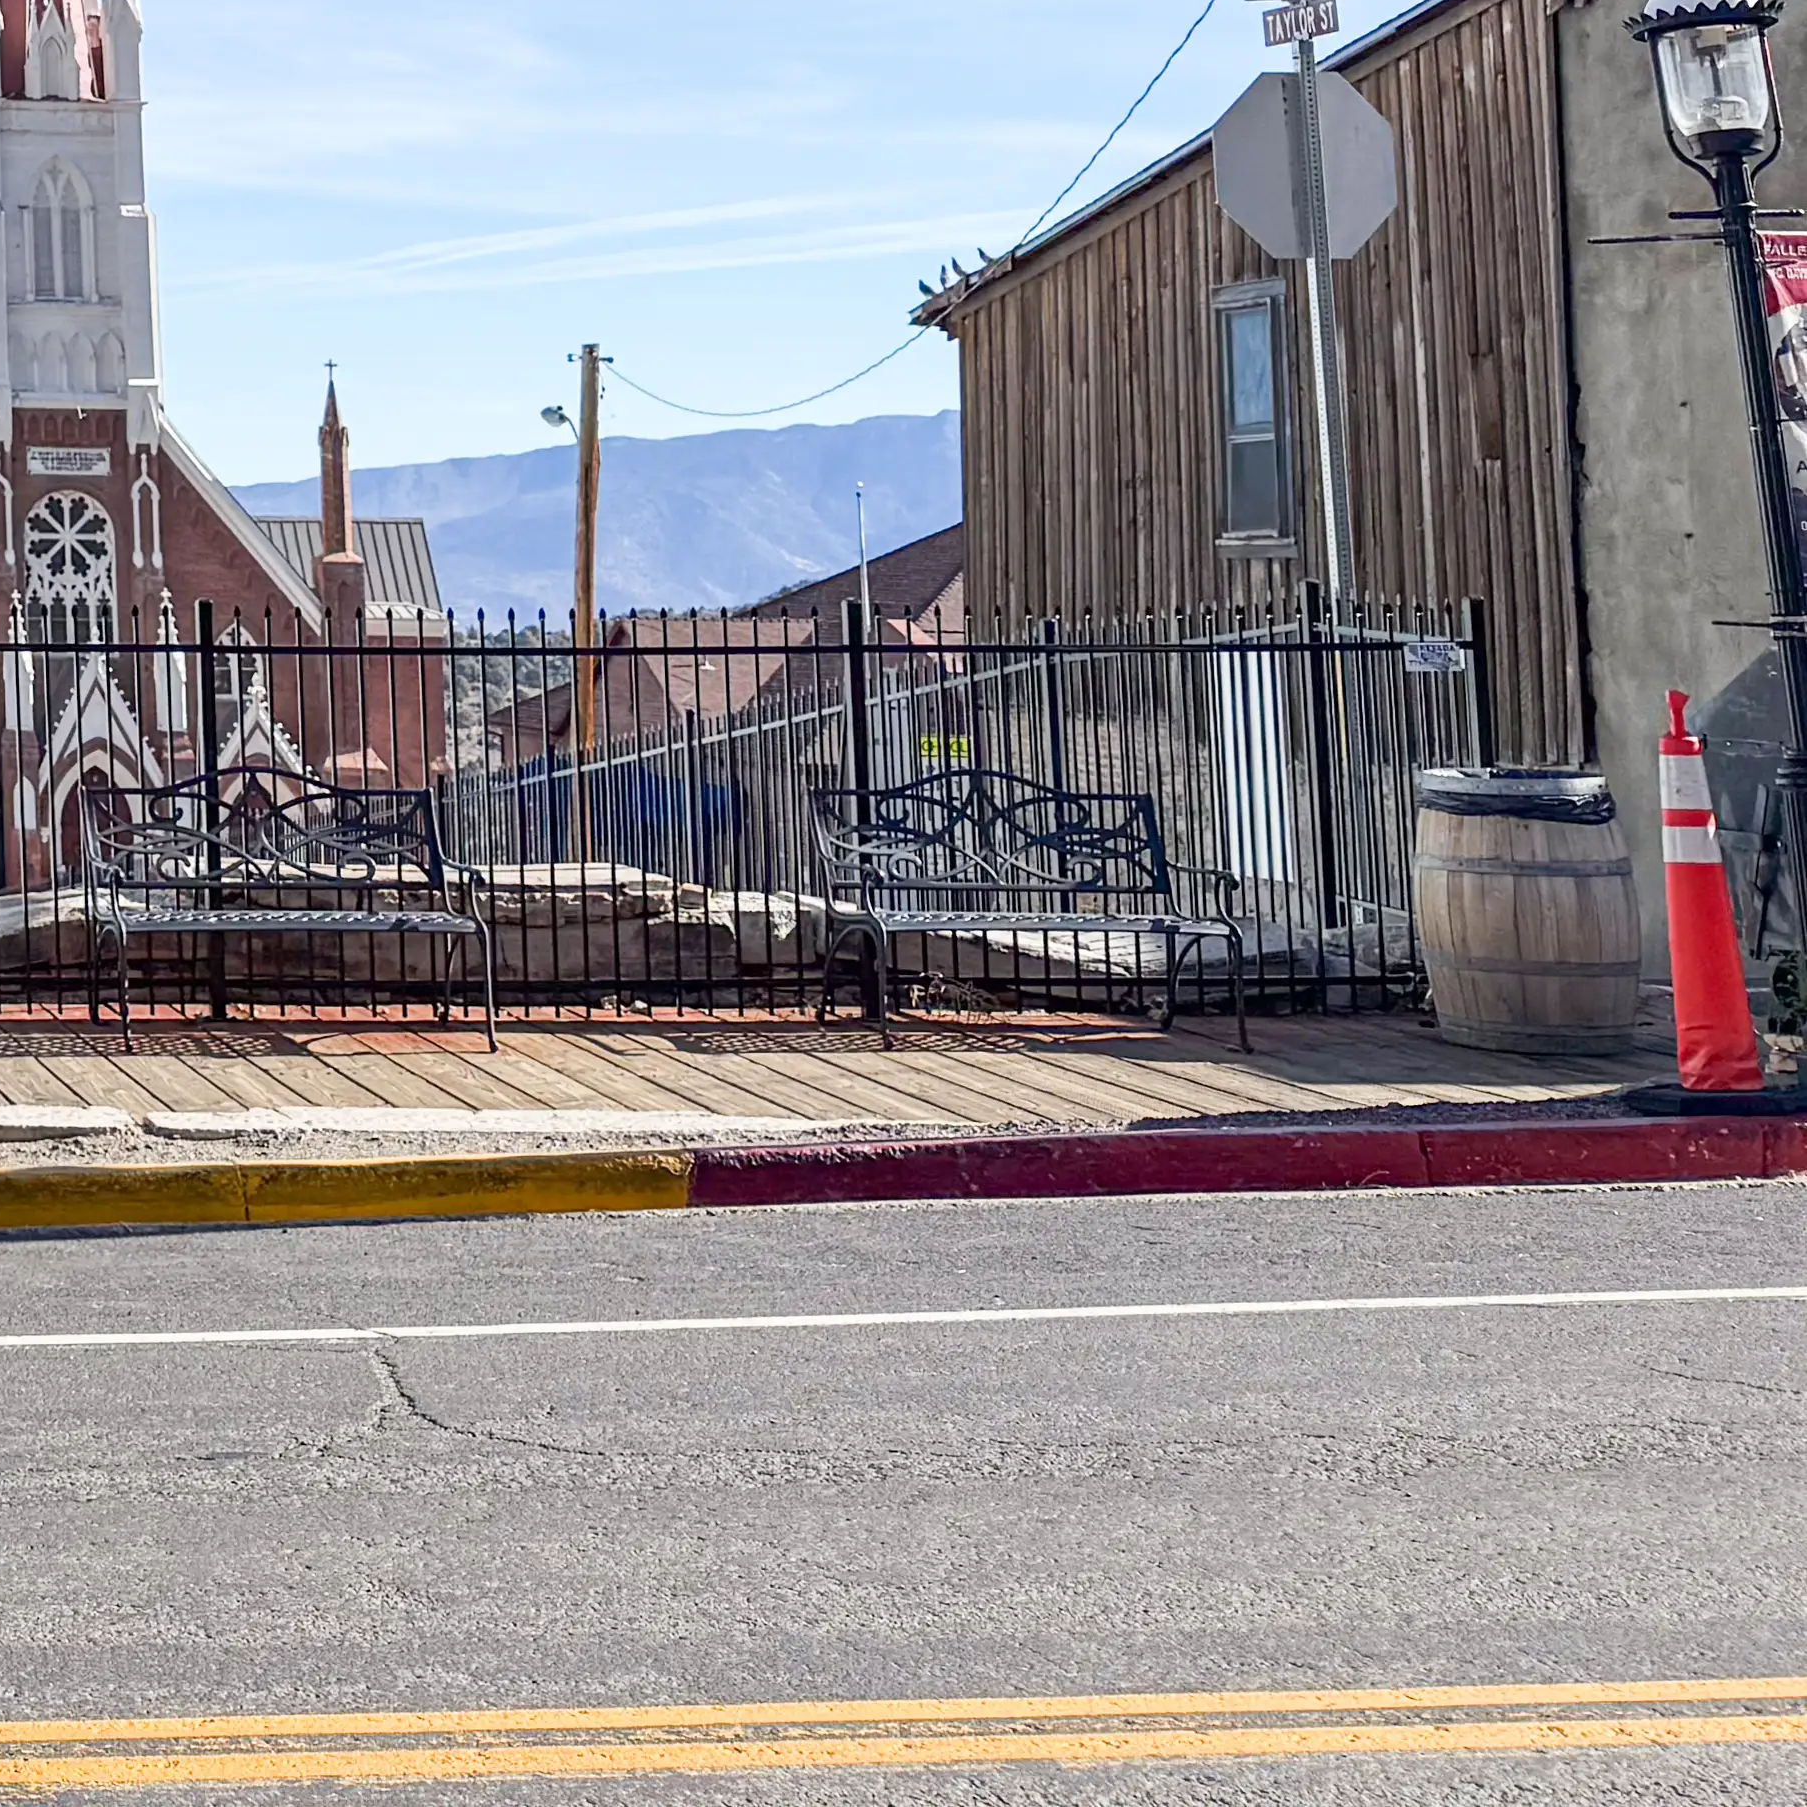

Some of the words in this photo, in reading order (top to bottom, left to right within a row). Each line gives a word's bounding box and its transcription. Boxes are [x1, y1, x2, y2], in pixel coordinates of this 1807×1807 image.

[1266, 5, 1317, 41] TAYLOR
[1319, 0, 1333, 31] ST
[1764, 244, 1807, 256] FALLE
